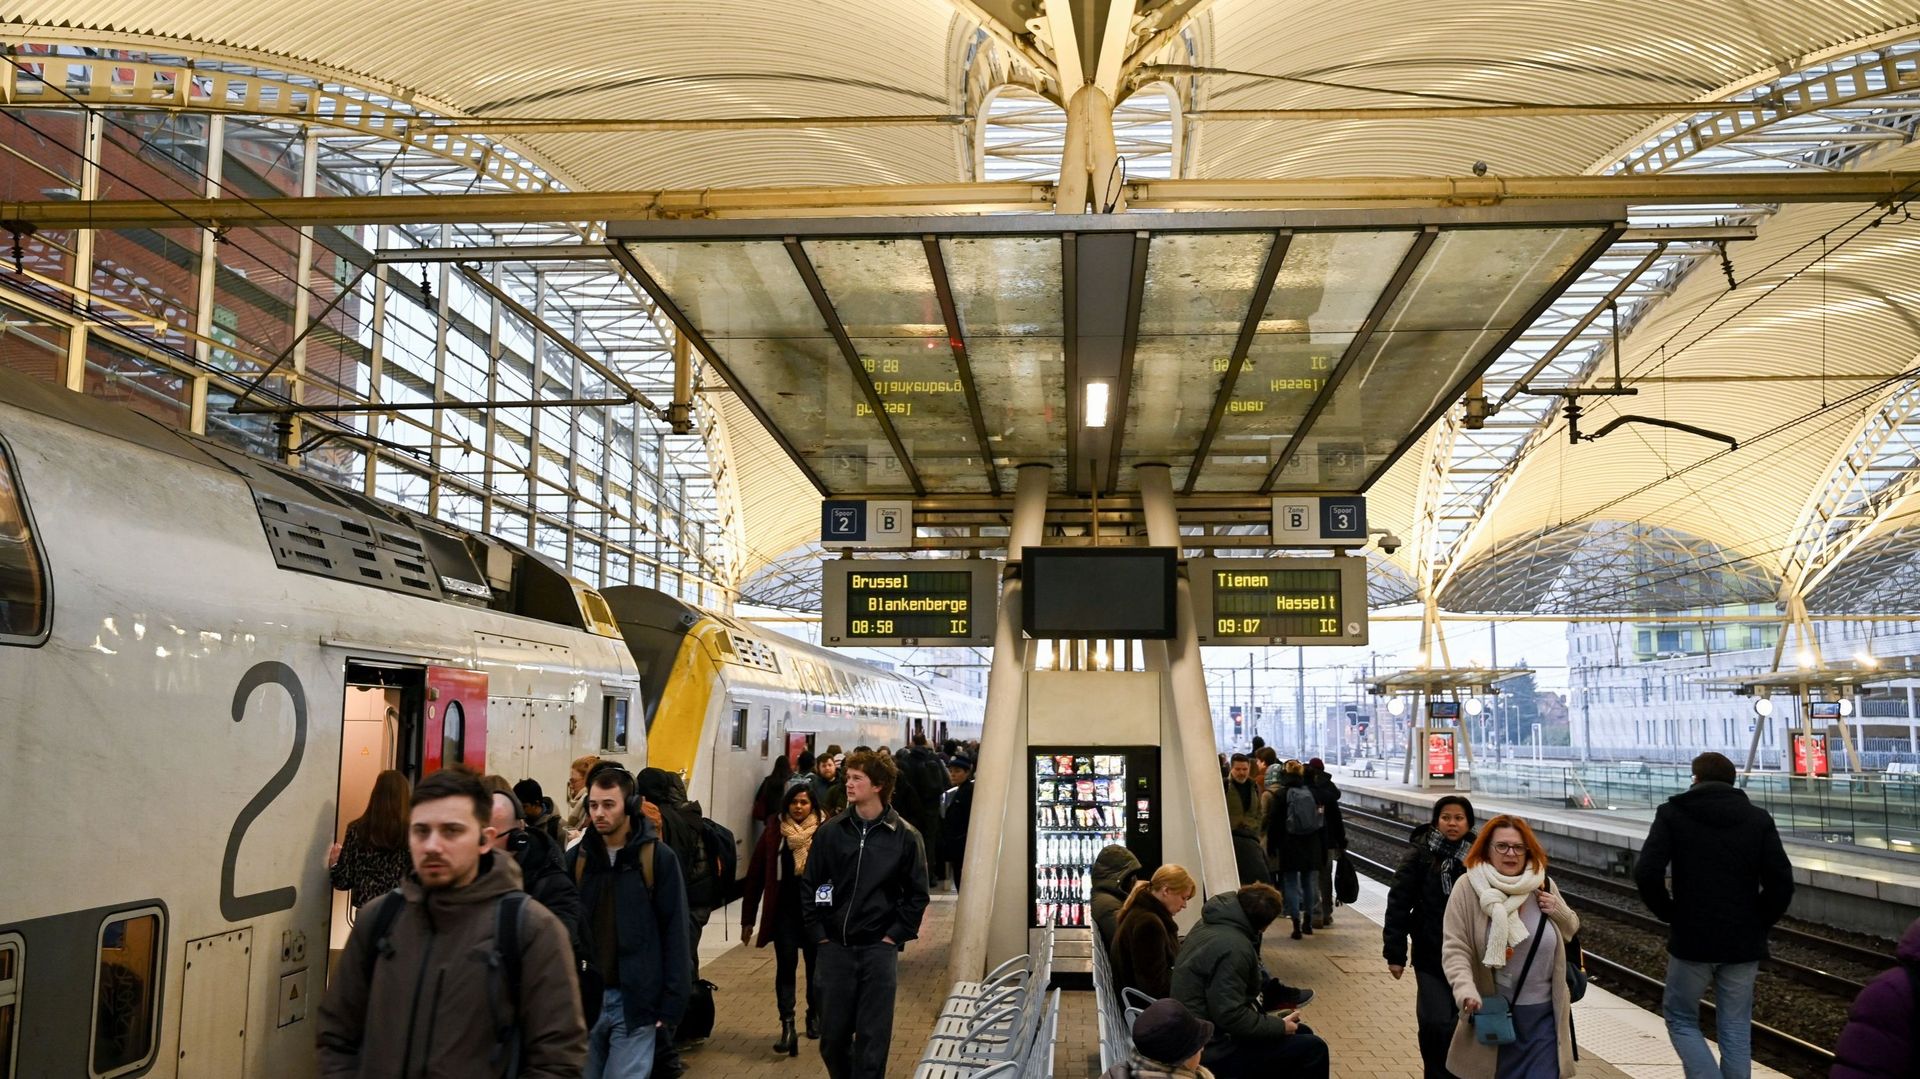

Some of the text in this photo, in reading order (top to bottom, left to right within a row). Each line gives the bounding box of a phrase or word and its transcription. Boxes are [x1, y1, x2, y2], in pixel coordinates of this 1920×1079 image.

[1333, 507, 1352, 515] Spoor
[839, 517, 849, 532] 2
[884, 516, 894, 530] B
[1291, 513, 1302, 528] B
[1338, 514, 1349, 529] 3
[852, 575, 908, 589] Brussel
[1217, 573, 1269, 587] Tienen
[868, 597, 967, 613] Blankenberge
[1276, 595, 1335, 610] Hasselt
[852, 620, 967, 634] 08:58 IC
[1218, 618, 1337, 633] 09:07 IC
[220, 660, 307, 922] 2
